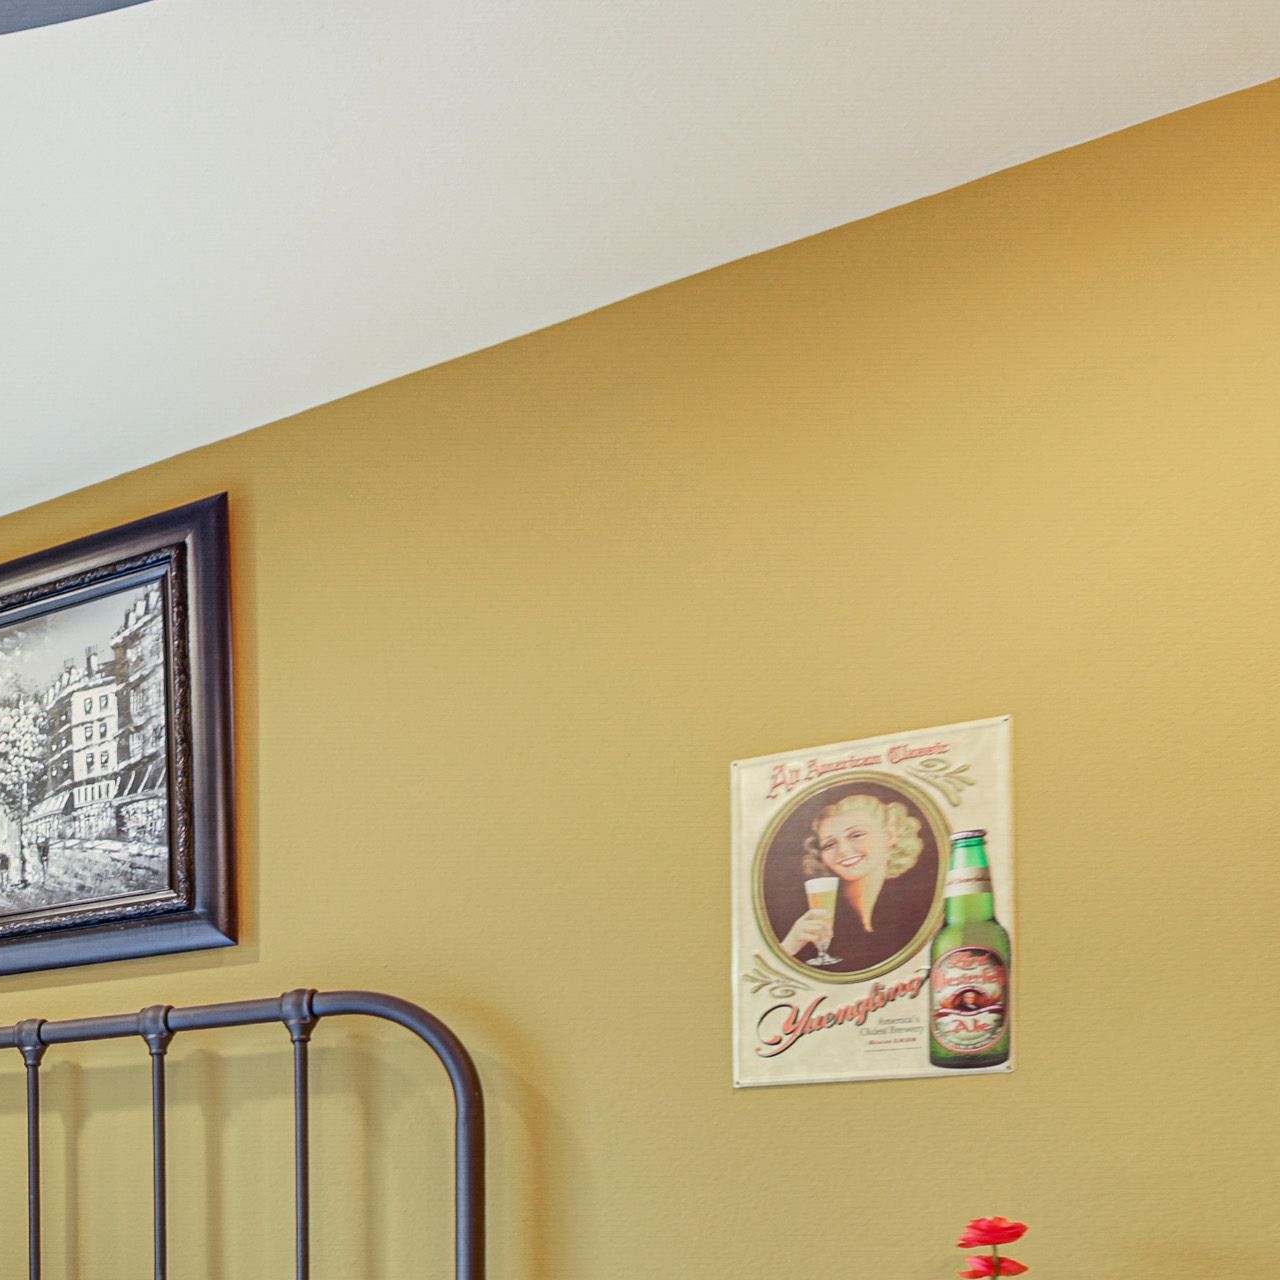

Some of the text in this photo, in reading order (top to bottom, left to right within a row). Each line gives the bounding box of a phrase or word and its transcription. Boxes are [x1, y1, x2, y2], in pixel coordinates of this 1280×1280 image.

[766, 764, 800, 799] An
[804, 755, 882, 781] American
[755, 968, 931, 1058] Yuengling
